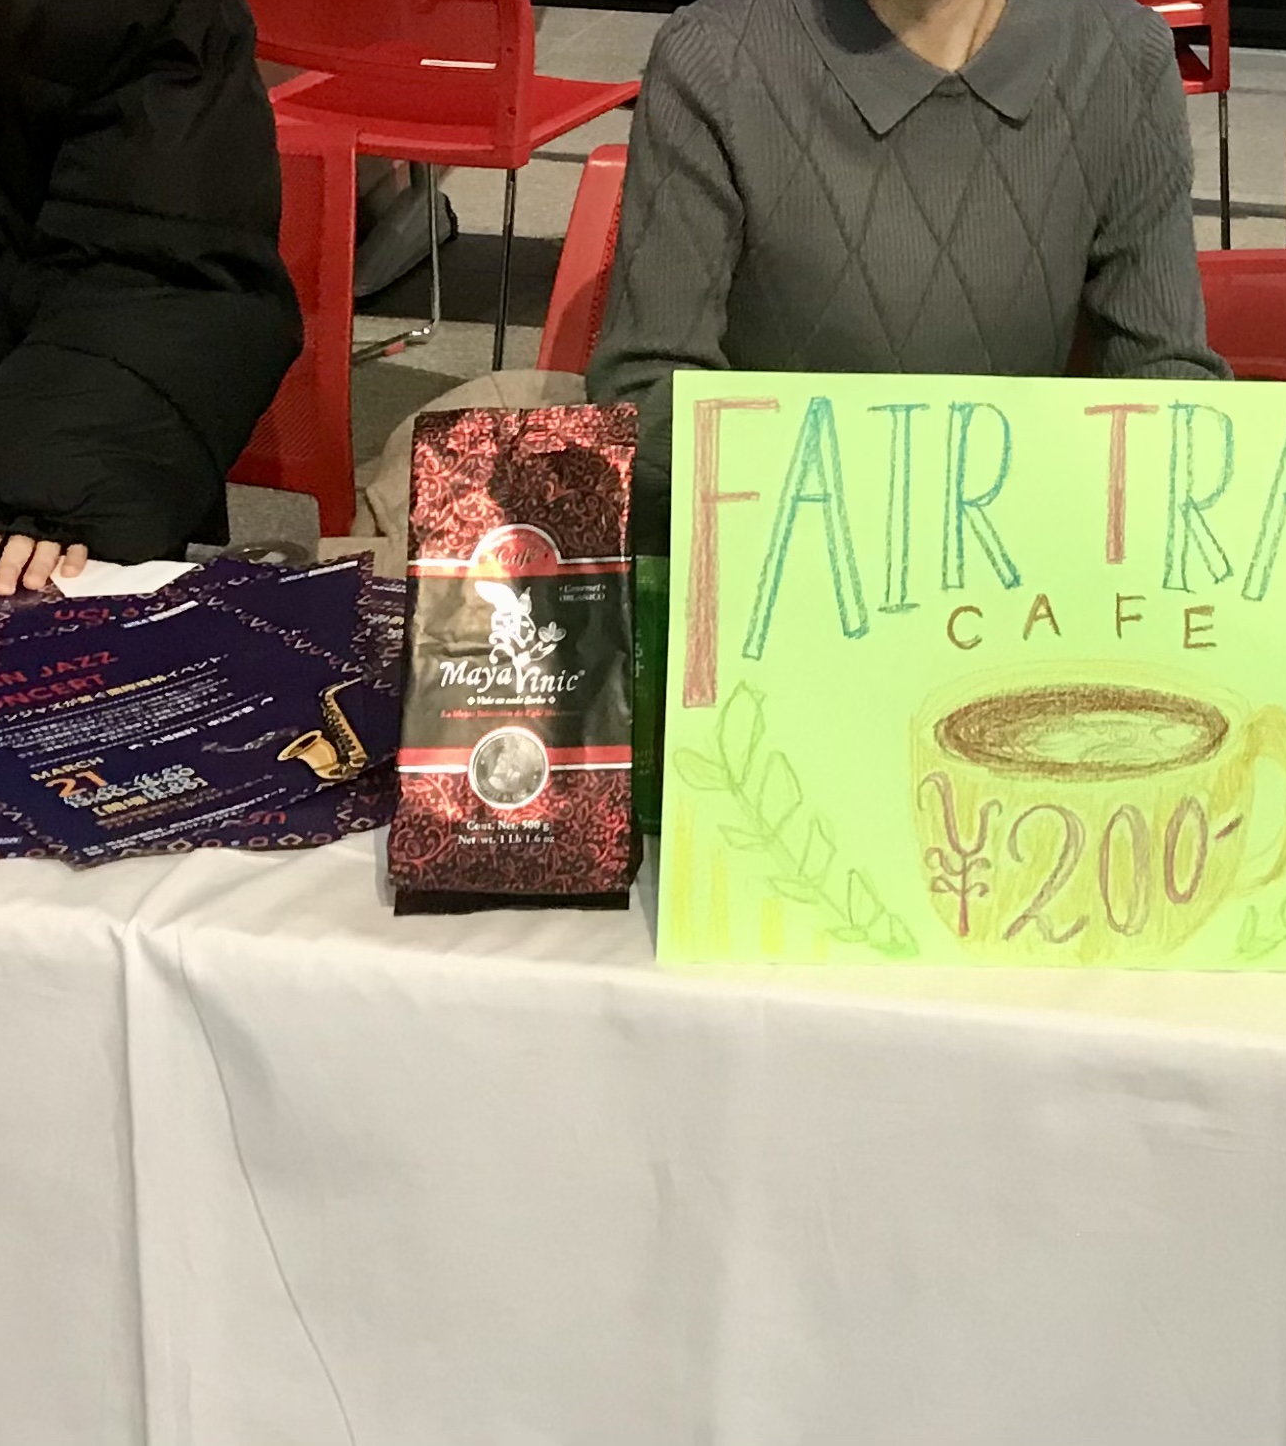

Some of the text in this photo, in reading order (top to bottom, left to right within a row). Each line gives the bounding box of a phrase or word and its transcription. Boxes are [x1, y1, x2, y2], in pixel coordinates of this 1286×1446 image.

[681, 395, 1023, 708] FAIR
[946, 593, 1217, 650] CAFE
[38, 651, 118, 678] JAZZ
[440, 660, 579, 694] Maya Vinic
[31, 757, 105, 782] MARCH
[45, 770, 108, 798] 21
[522, 820, 539, 830] 500
